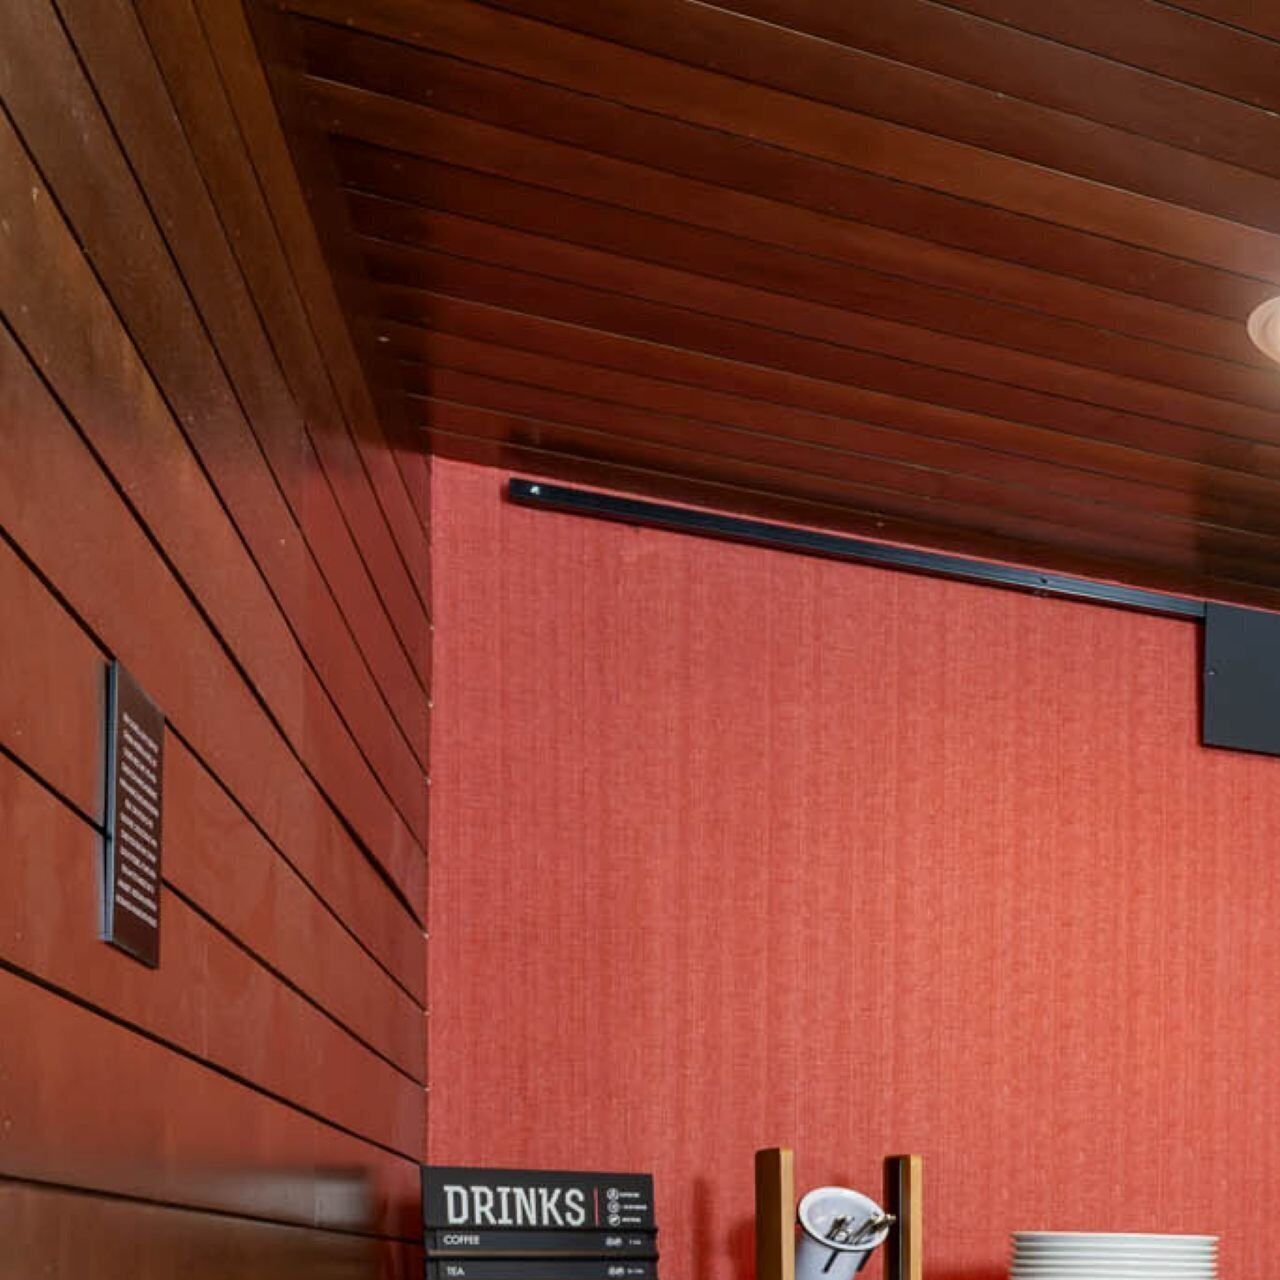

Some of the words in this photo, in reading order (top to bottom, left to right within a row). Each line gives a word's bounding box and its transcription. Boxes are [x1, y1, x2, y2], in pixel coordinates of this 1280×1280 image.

[443, 1185, 586, 1227] DRINKS
[443, 1234, 480, 1246] COFFEE
[447, 1266, 465, 1277] TEA
